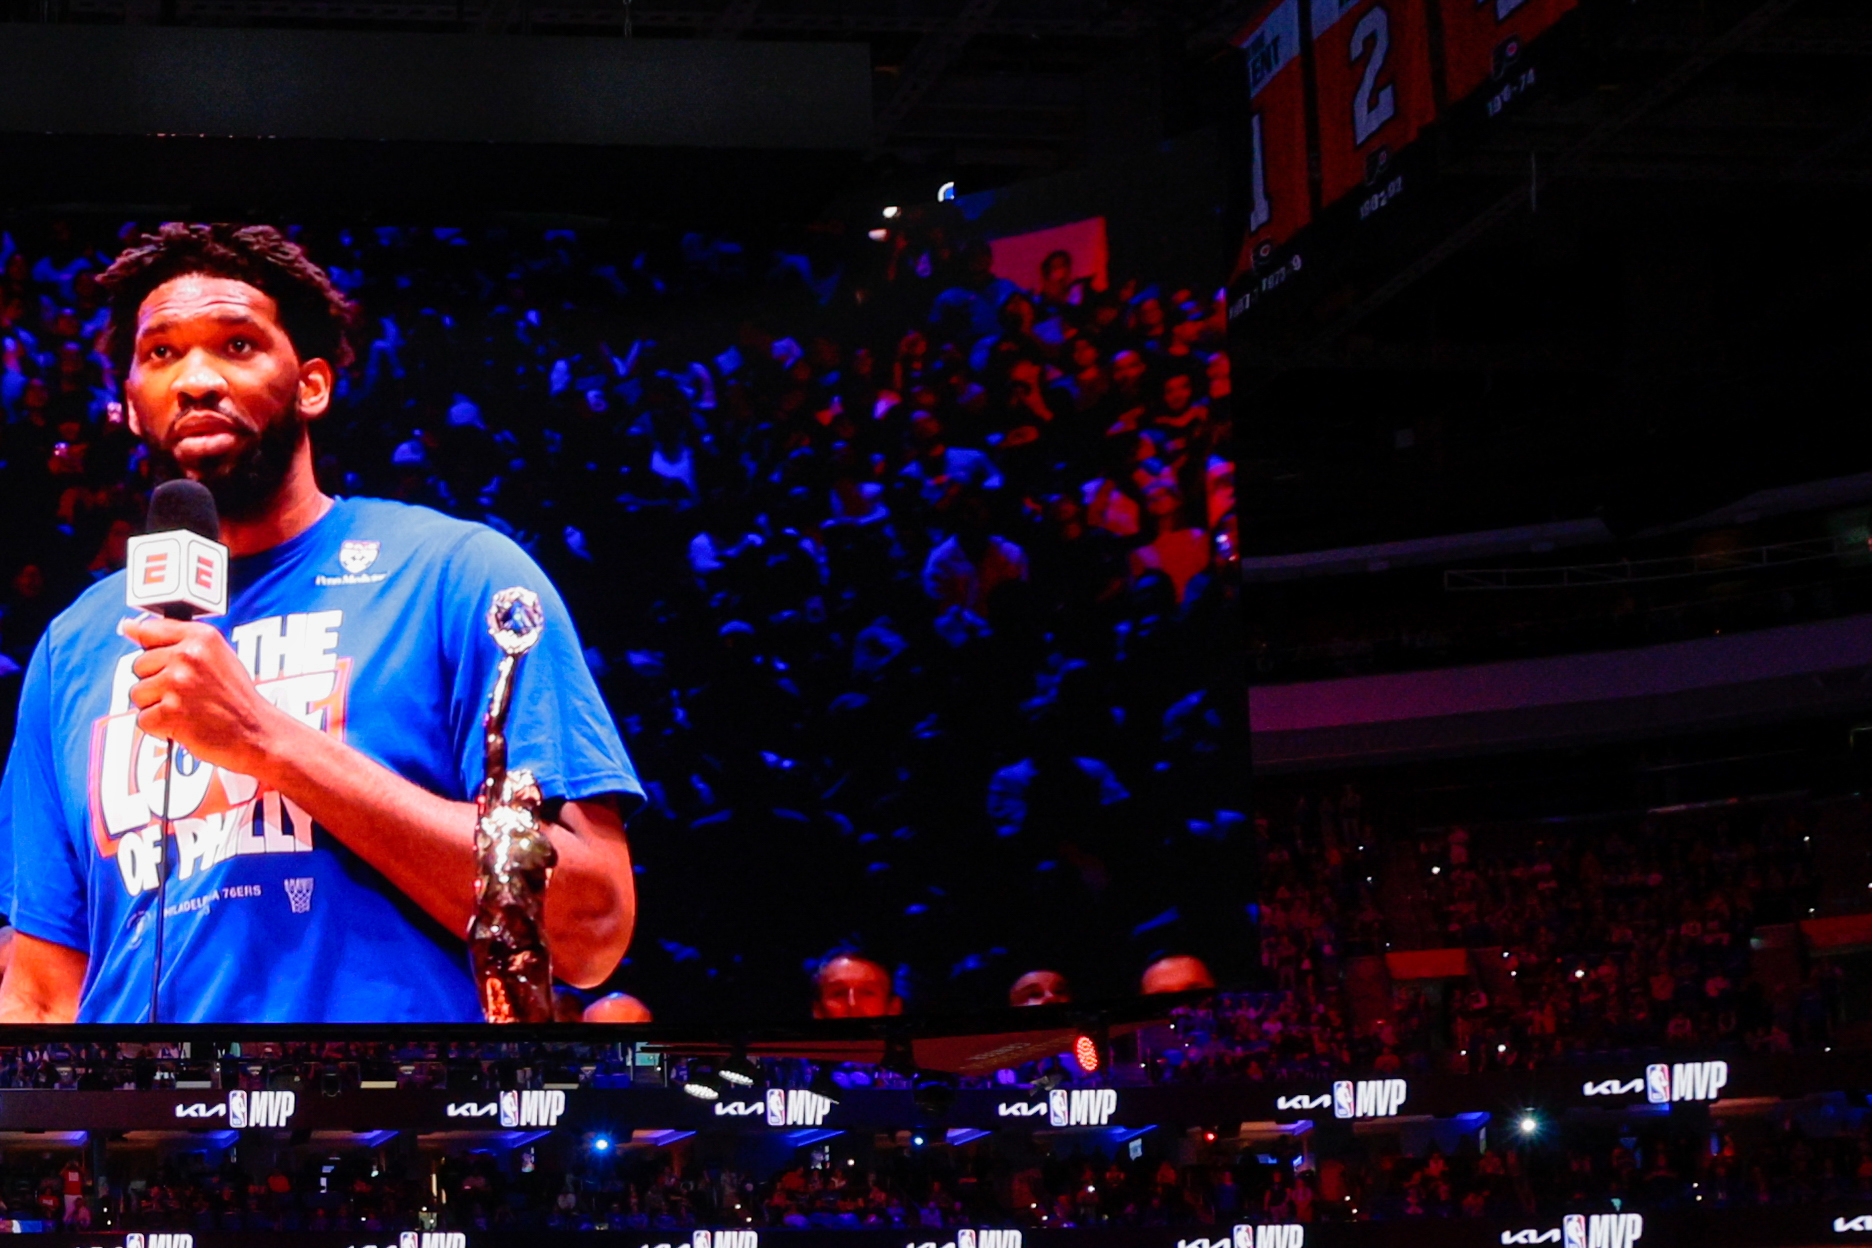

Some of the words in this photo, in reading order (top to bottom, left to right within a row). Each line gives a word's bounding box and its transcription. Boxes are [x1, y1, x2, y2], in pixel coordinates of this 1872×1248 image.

[1349, 4, 1397, 147] 2
[231, 609, 343, 685] THE
[117, 823, 165, 897] OF
[172, 787, 314, 881] PHILLY
[222, 884, 262, 901] 76ERS
[1356, 1079, 1406, 1117] MVP
[1672, 1061, 1727, 1102] MVP
[249, 1091, 295, 1127] MVP
[520, 1090, 566, 1126] MVP
[787, 1089, 831, 1125] MVP
[1070, 1089, 1117, 1125] MVP
